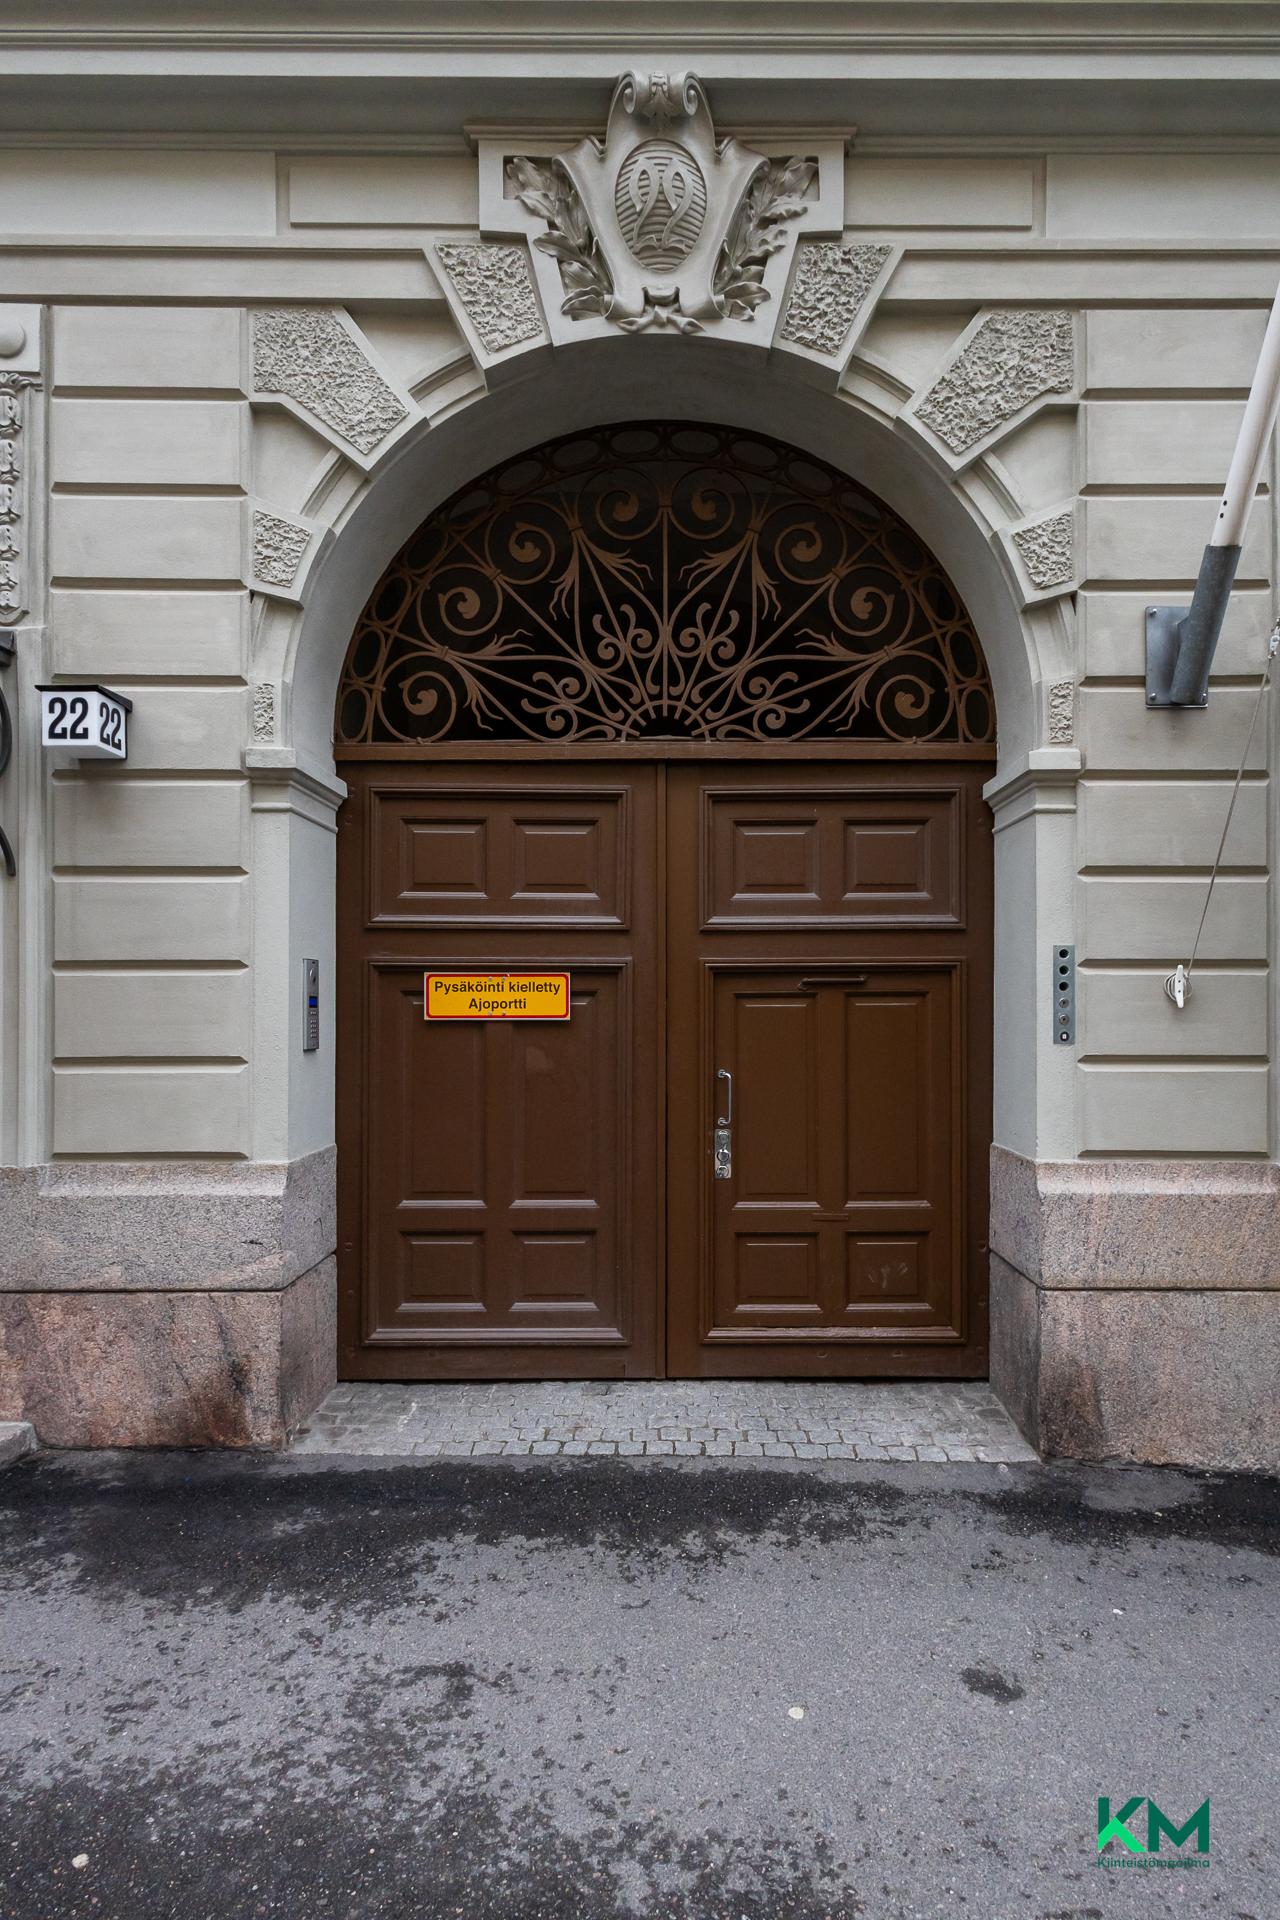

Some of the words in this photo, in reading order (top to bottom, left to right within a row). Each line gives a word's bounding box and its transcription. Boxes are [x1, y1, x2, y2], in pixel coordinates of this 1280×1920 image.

[48, 697, 88, 739] 22
[100, 702, 121, 751] 22
[434, 982, 504, 995] Pysäköinti
[509, 982, 560, 995] kielletty
[469, 998, 526, 1011] Ajoportti
